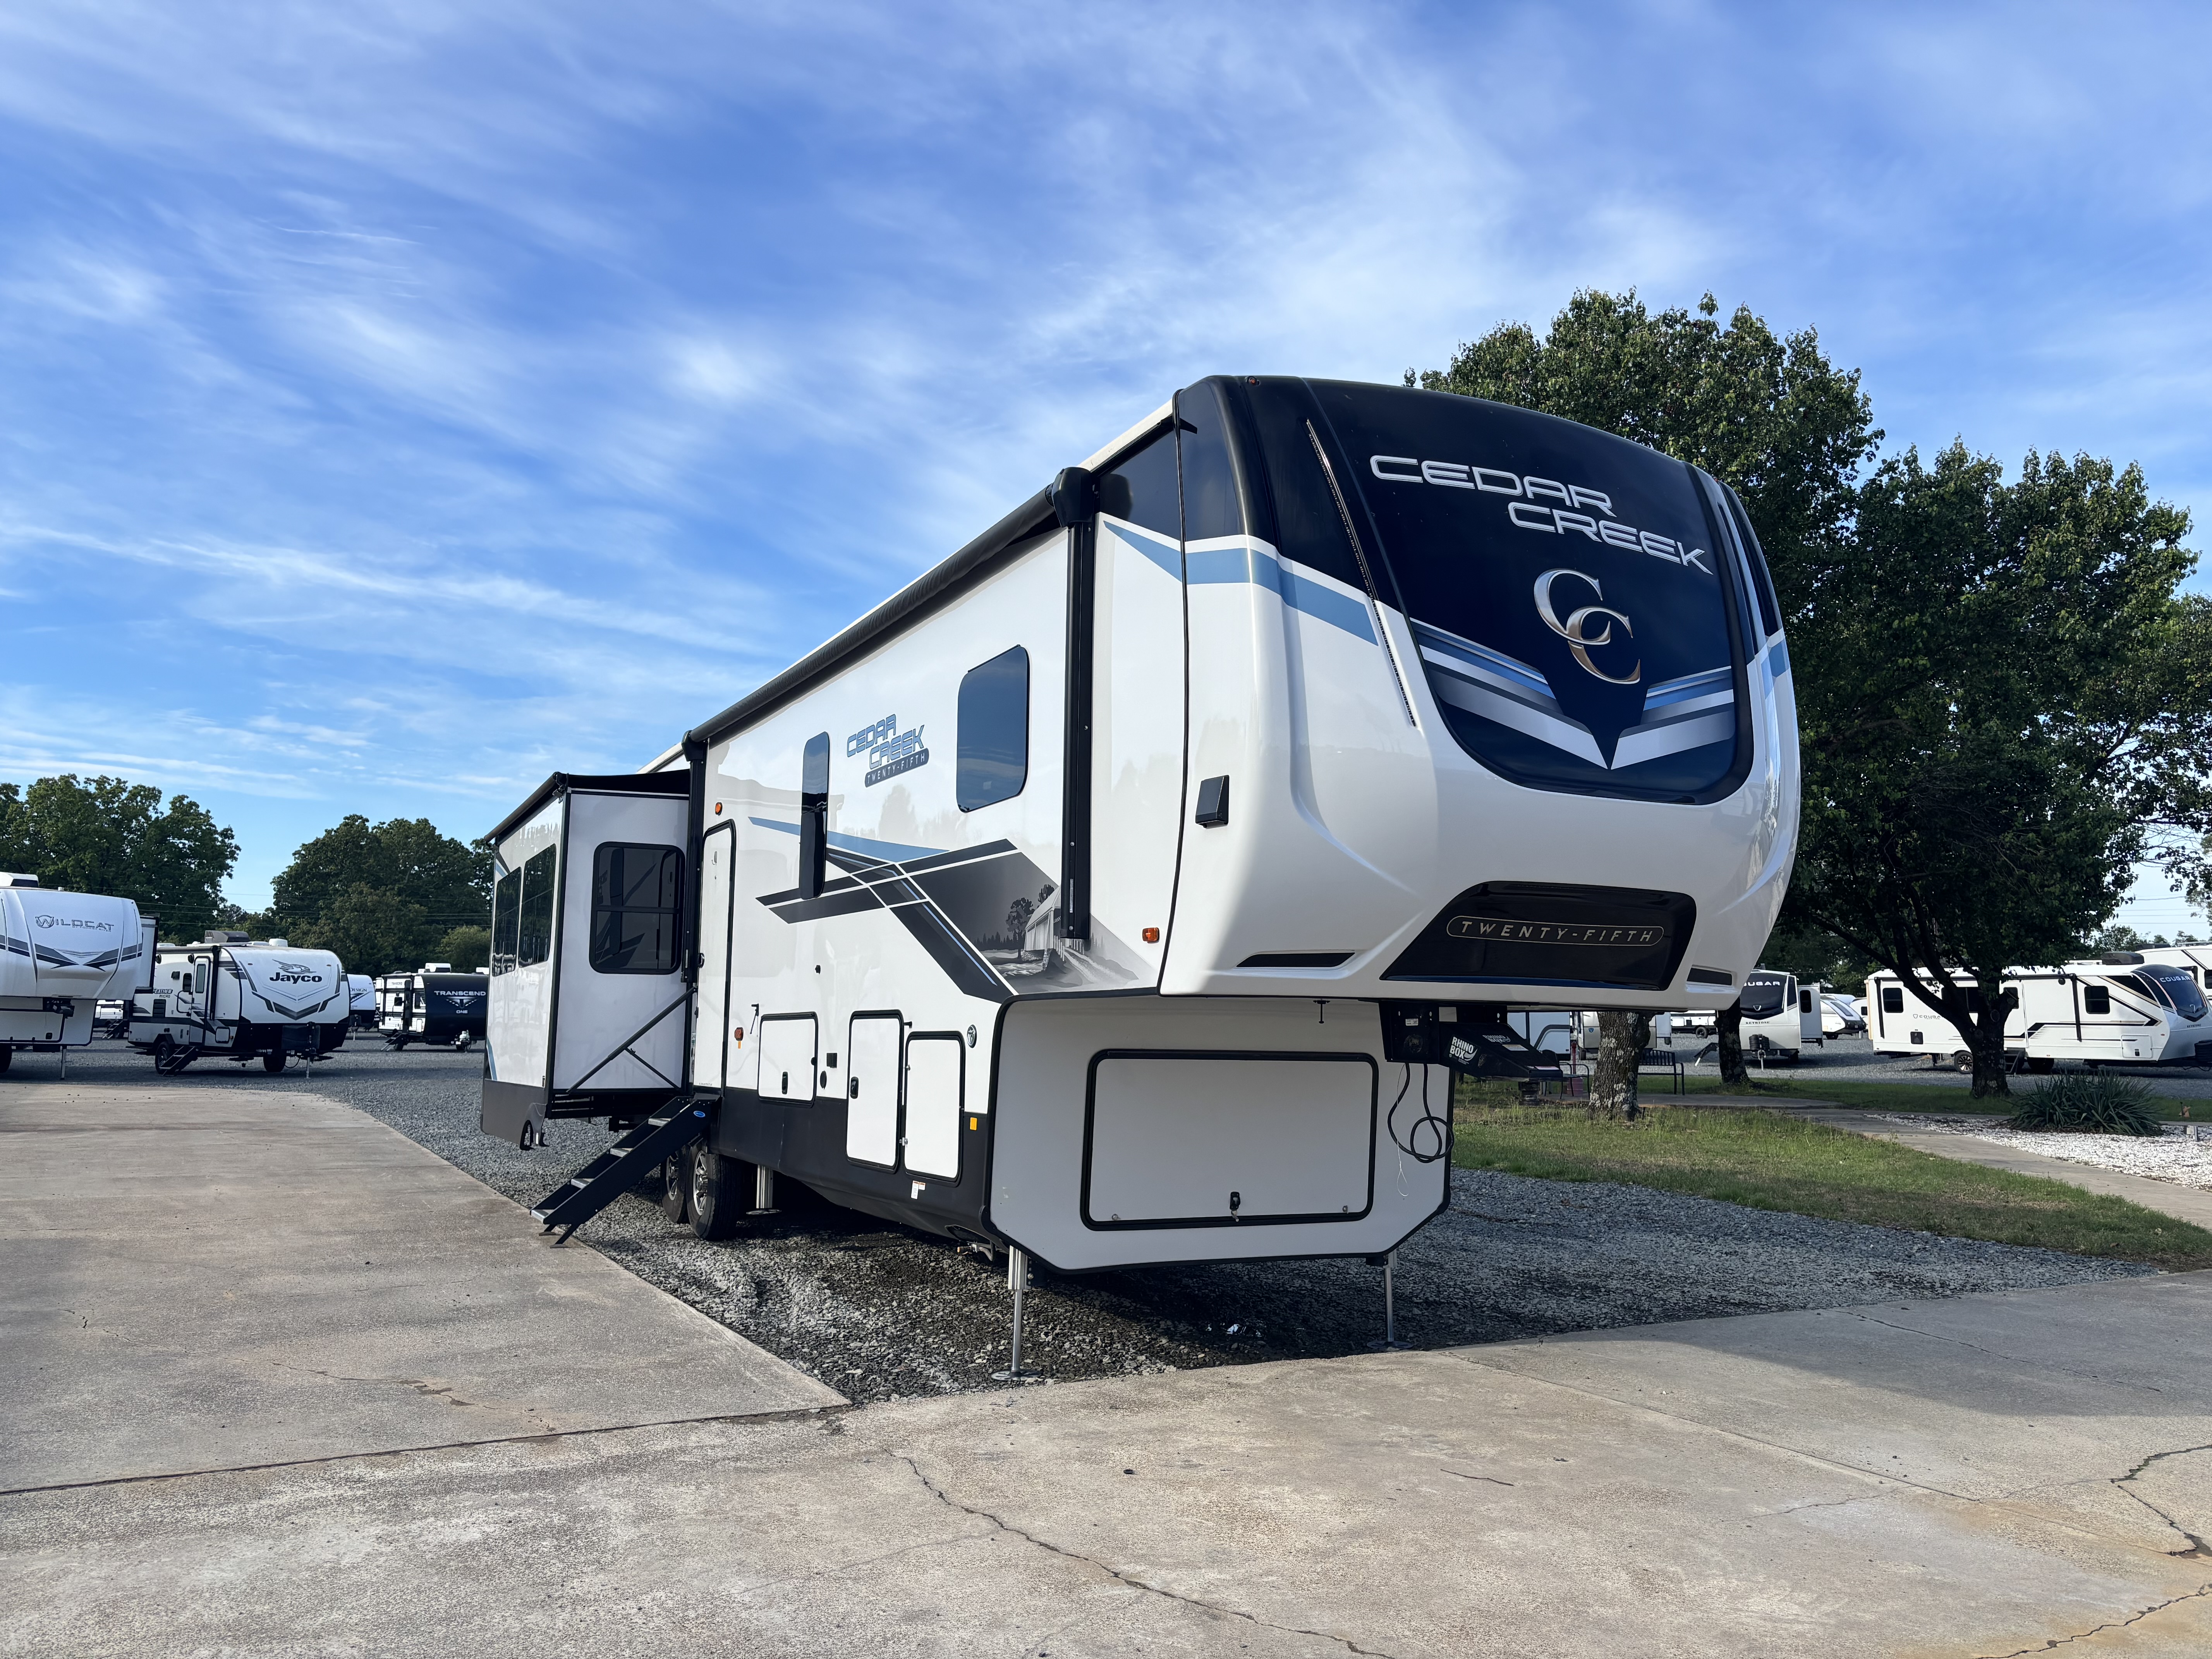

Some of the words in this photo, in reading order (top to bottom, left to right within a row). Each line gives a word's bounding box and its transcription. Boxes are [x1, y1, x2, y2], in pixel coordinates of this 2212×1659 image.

[1370, 455, 1617, 517] CEDAR
[1508, 502, 1714, 575] CREEK
[847, 714, 896, 757] CEDAR
[869, 724, 925, 770] CREEK
[35, 915, 114, 931] WILDCAT
[1461, 921, 1653, 942] TWENTY-FIFTH
[269, 972, 322, 984] Jayco
[1449, 1045, 1465, 1060] BOX
[1451, 1036, 1474, 1053] RHINO
